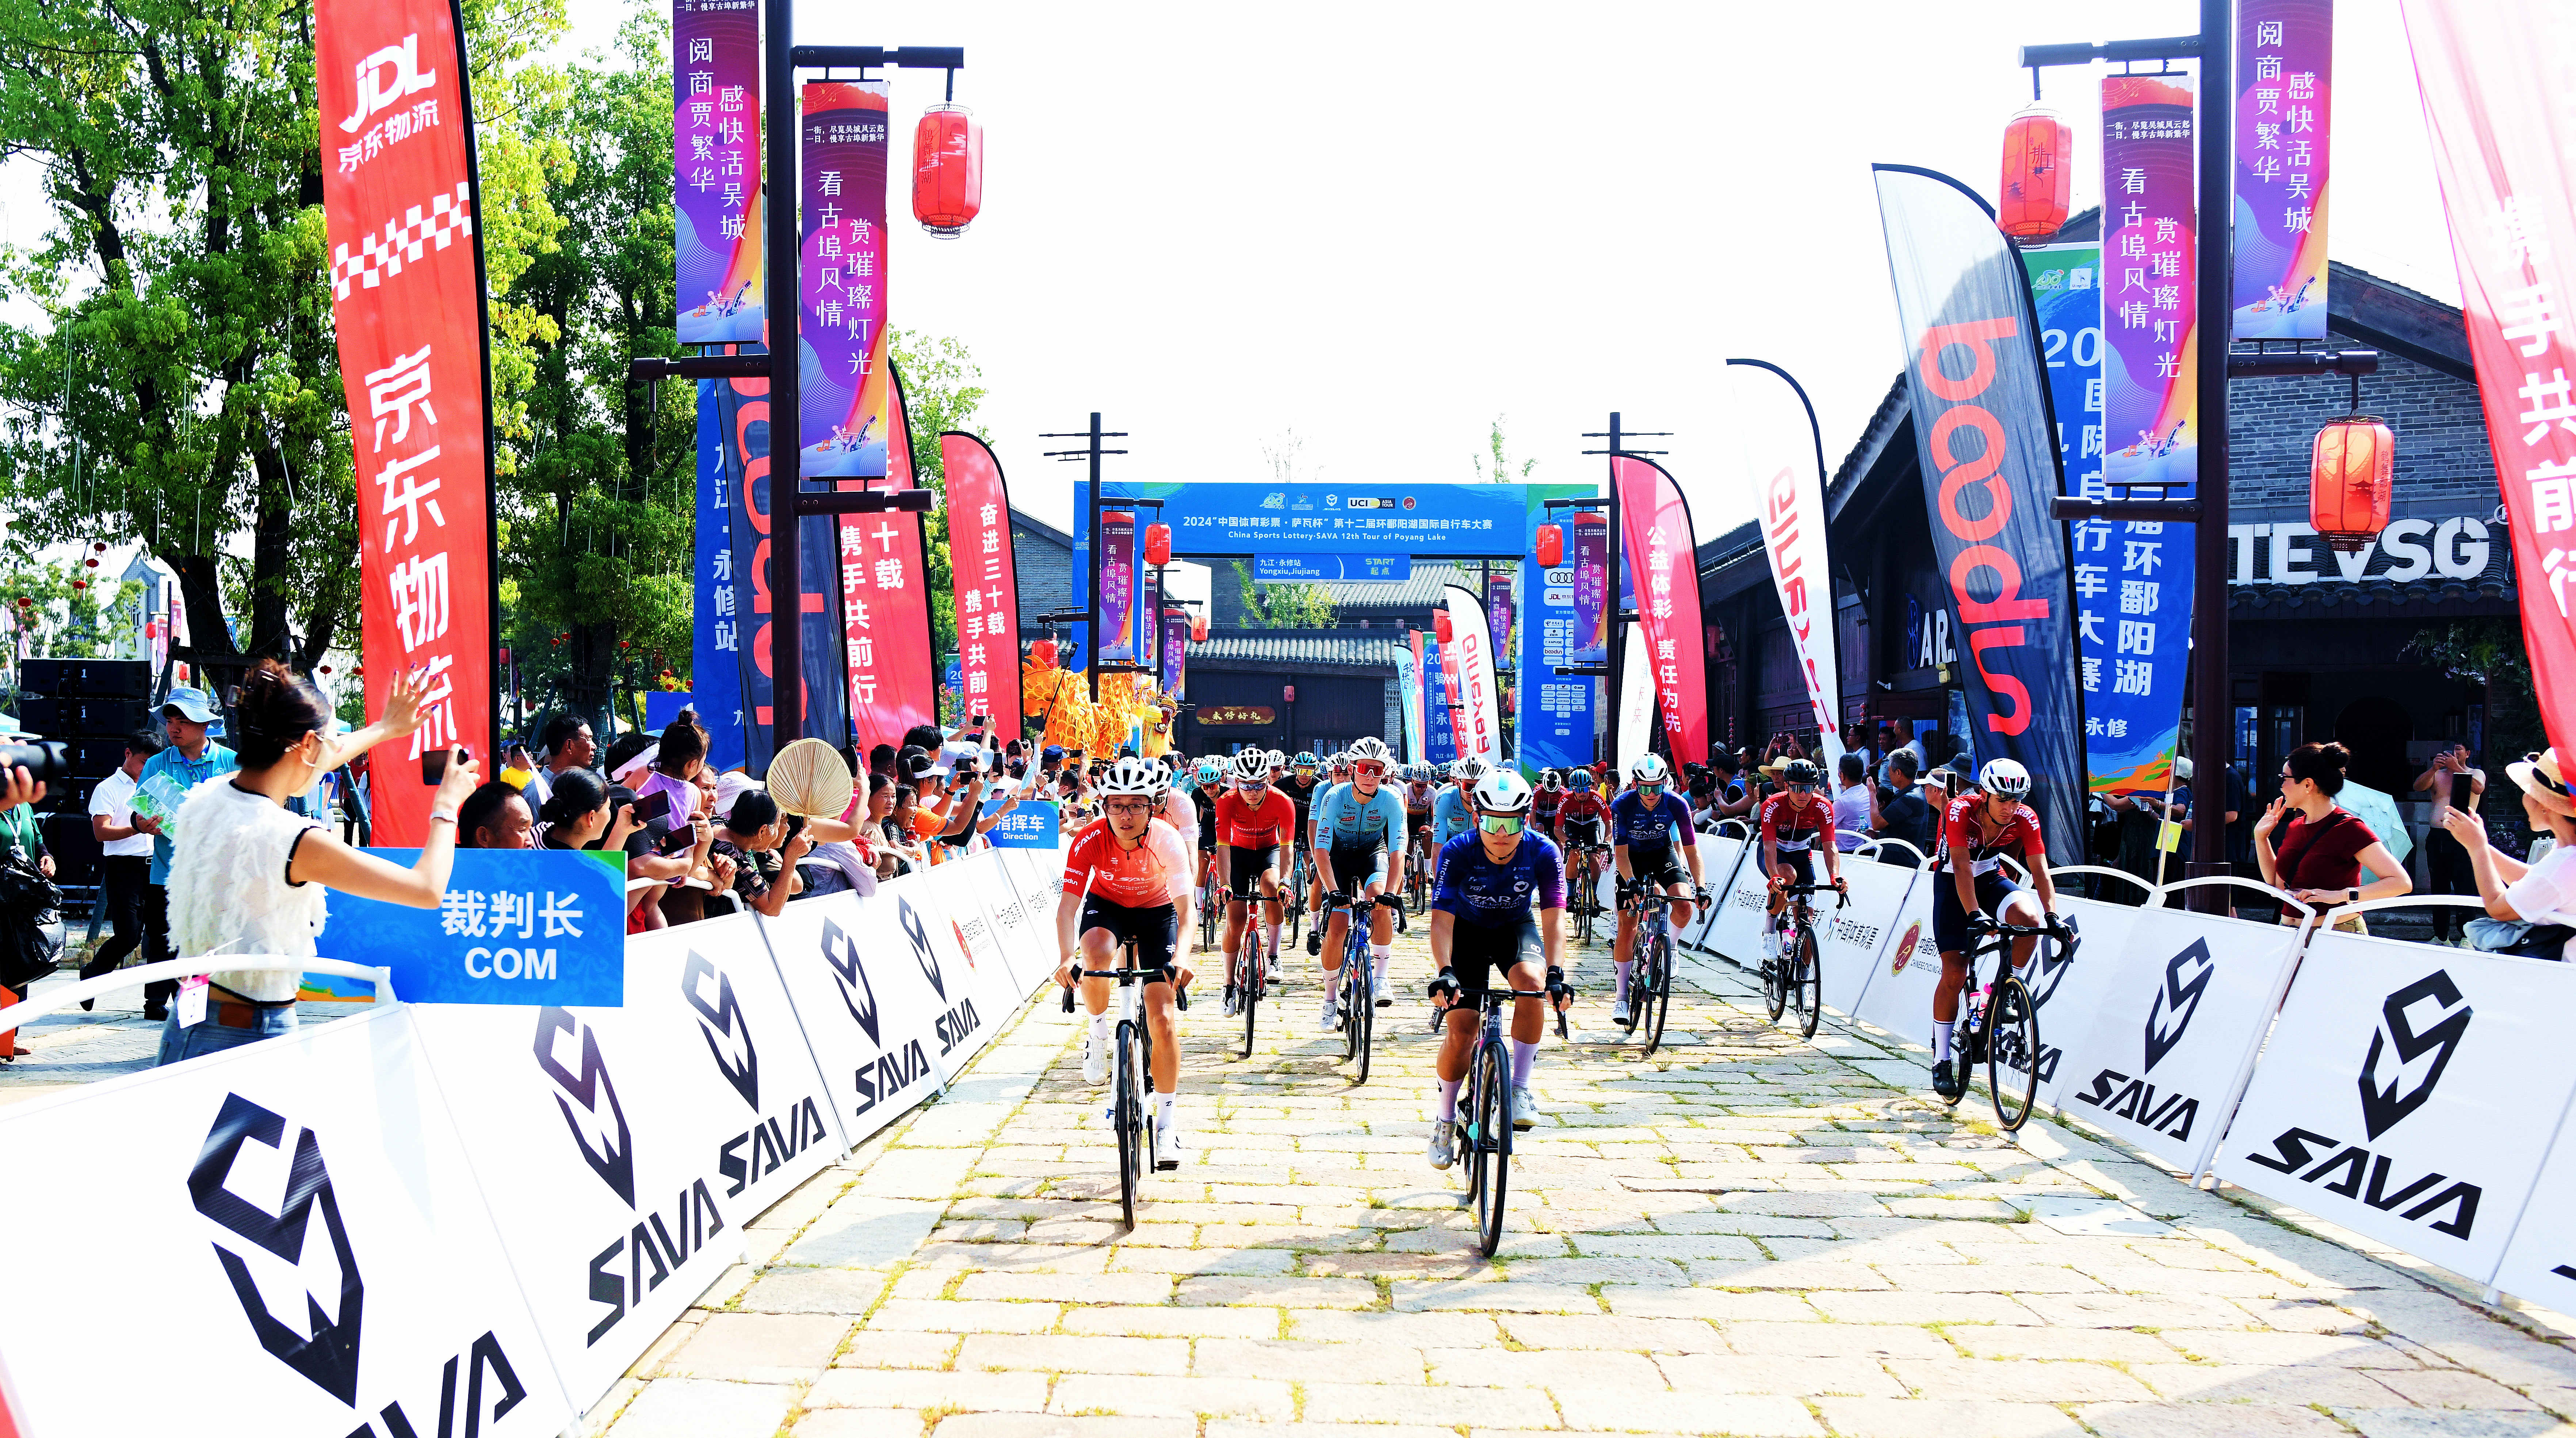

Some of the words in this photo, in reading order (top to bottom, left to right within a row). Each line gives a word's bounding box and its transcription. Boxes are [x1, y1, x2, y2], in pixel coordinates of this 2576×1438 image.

[339, 33, 439, 133] JDL
[689, 38, 715, 193] 阅商贾繁华
[2252, 21, 2283, 183] 阅商贾繁华
[339, 99, 439, 173] 京东物流
[806, 124, 884, 134] 一街，尽览吴城风云起
[2106, 120, 2190, 130] 一街，尽览吴城风云起
[2284, 71, 2315, 234] 感快活吴城
[719, 85, 746, 240] 感快活吴城
[815, 171, 845, 327] 看古埠风情
[2118, 168, 2150, 329] 看古埠风情
[847, 218, 874, 374] 赏璀璨灯光
[2152, 217, 2182, 378] 赏璀璨灯光
[1334, 518, 1492, 529] 第十二届环鄱阳湖国际自行车大赛
[1918, 316, 2050, 736] boodun
[980, 503, 1005, 635] 奋进三十载
[1106, 544, 1117, 603] 看古埠风情
[1117, 563, 1128, 621] 赏璀璨灯光
[1371, 567, 1389, 575] 起点
[1579, 546, 1590, 605] 看古埠风情
[1591, 564, 1602, 623] 赏璀璨灯光
[1646, 525, 1673, 620] 公益体彩
[965, 588, 989, 717] 携手共前行
[1658, 639, 1681, 732] 责任为先
[995, 814, 1045, 833] 指挥车
[1557, 798, 1568, 814] SRBIJA
[1592, 795, 1605, 810] SRBIJA
[1763, 802, 1779, 823] SRBIJA
[1816, 802, 1832, 824] SRBIJA
[1074, 829, 1101, 857] SAVA
[1433, 859, 1450, 900] MITCHELTON
[441, 889, 584, 939] 裁判长
[1835, 918, 1879, 950] 中国体育彩票
[465, 947, 557, 979] COM
[935, 998, 981, 1061] SAVA
[856, 1039, 930, 1117] SAVA
[2075, 1069, 2199, 1142] SAVA
[719, 1096, 826, 1199] SAVA
[2245, 1127, 2482, 1240] SAVA
[587, 1178, 724, 1349] SAVA
